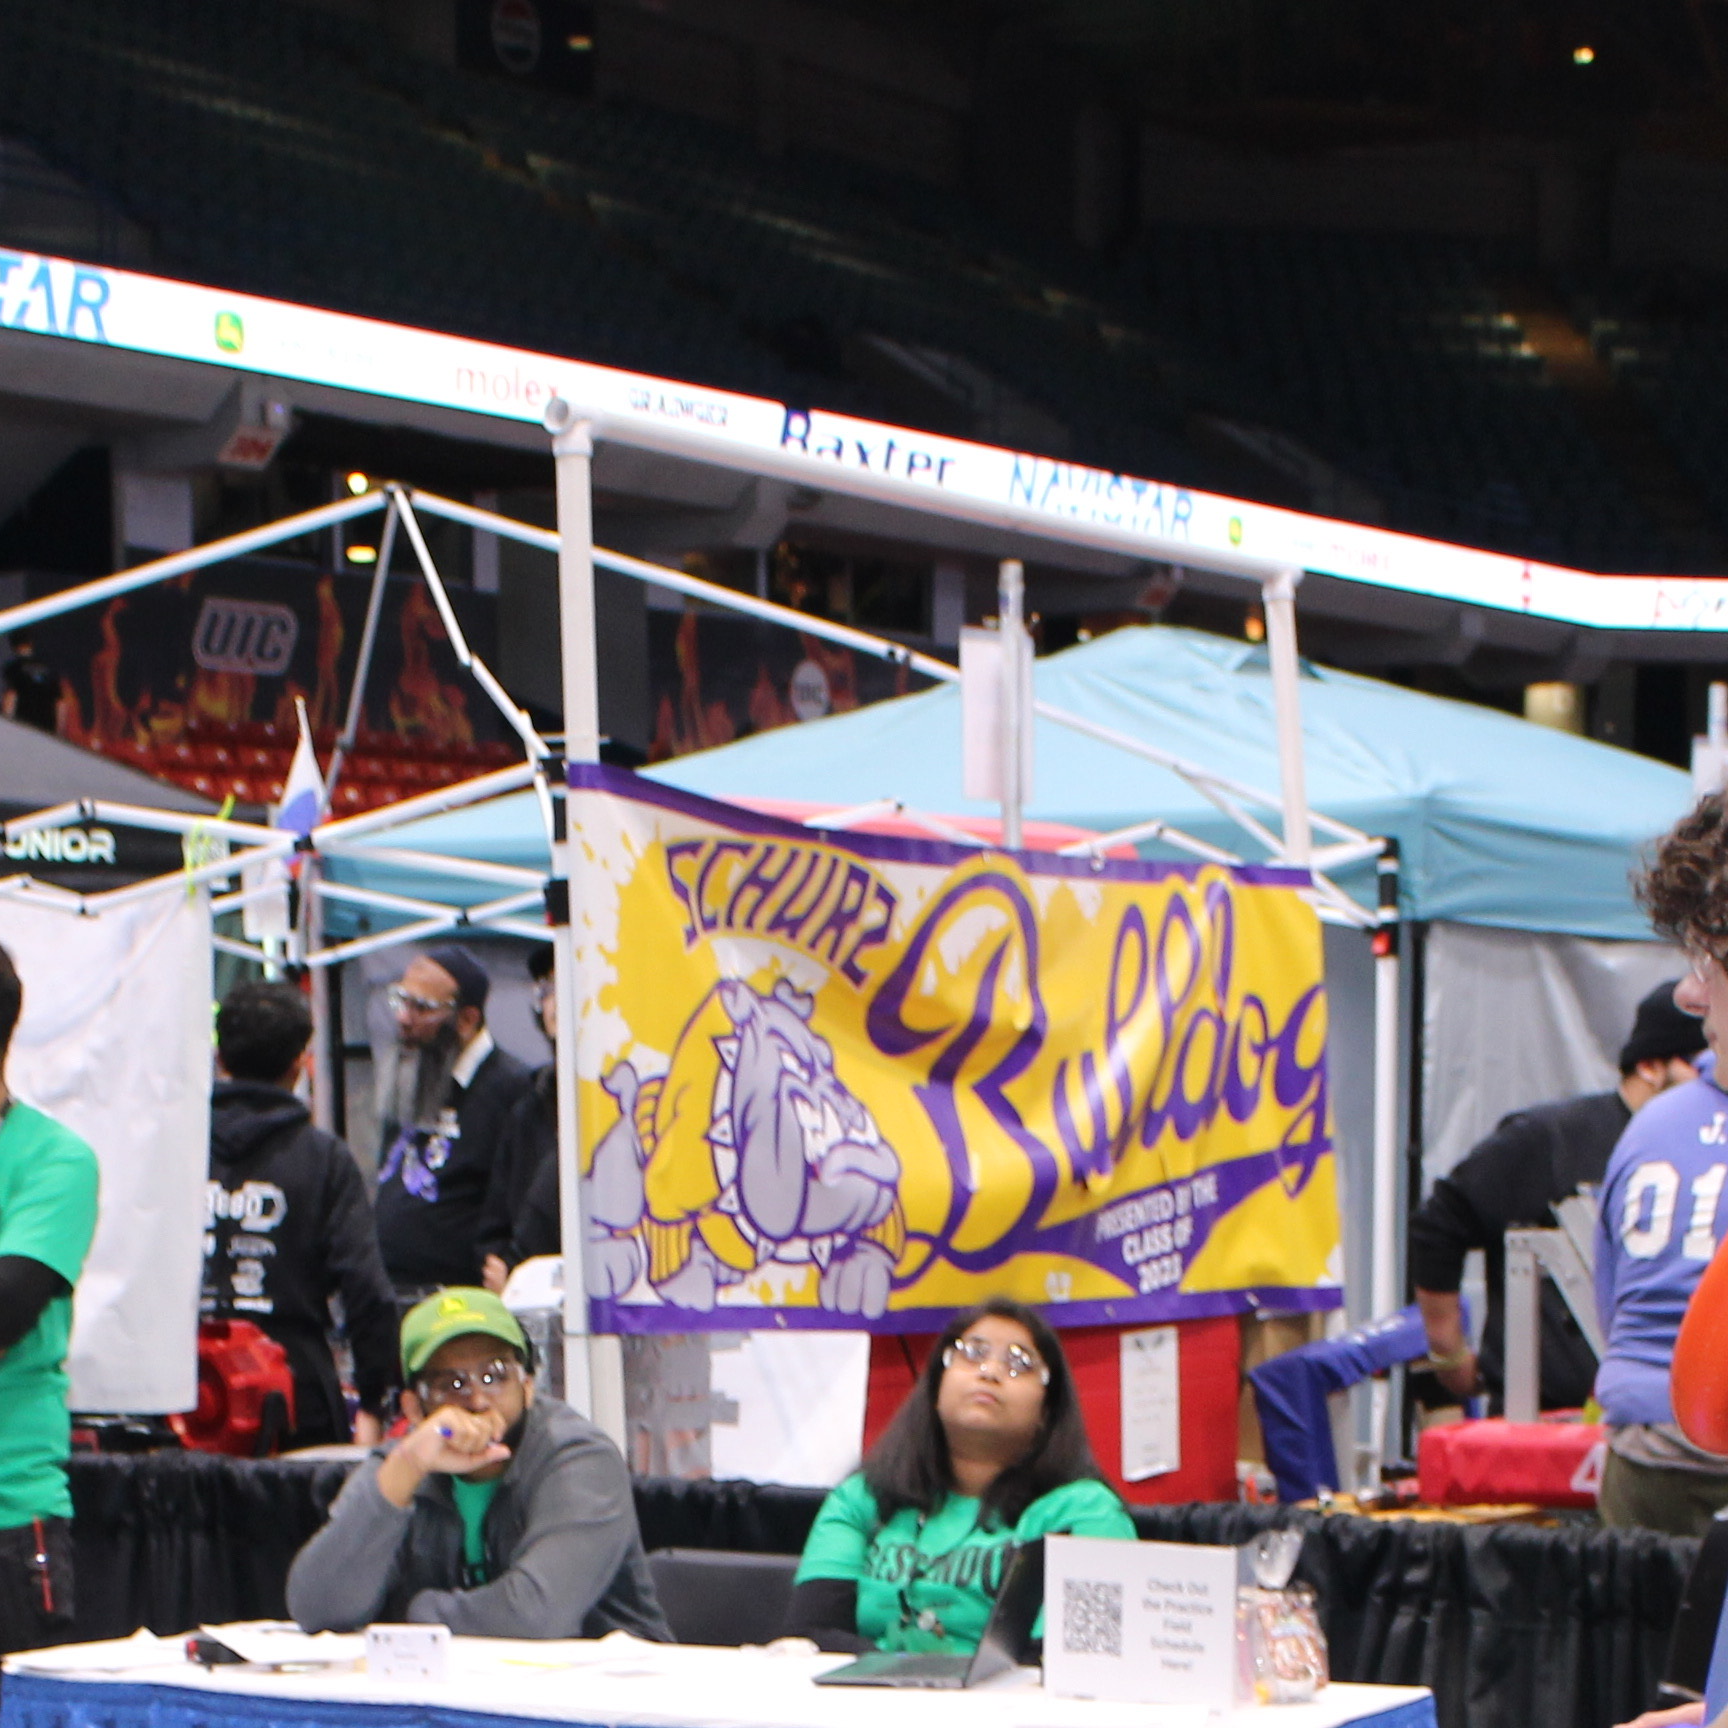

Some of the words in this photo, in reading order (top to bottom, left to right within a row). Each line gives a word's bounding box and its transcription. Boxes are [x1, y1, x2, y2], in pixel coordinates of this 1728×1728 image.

[779, 406, 956, 485] Baxter
[201, 603, 294, 661] UIC
[666, 838, 898, 987] SCHURZ
[1094, 1188, 1175, 1244] PRESENTED
[1122, 1221, 1173, 1267] CLASS
